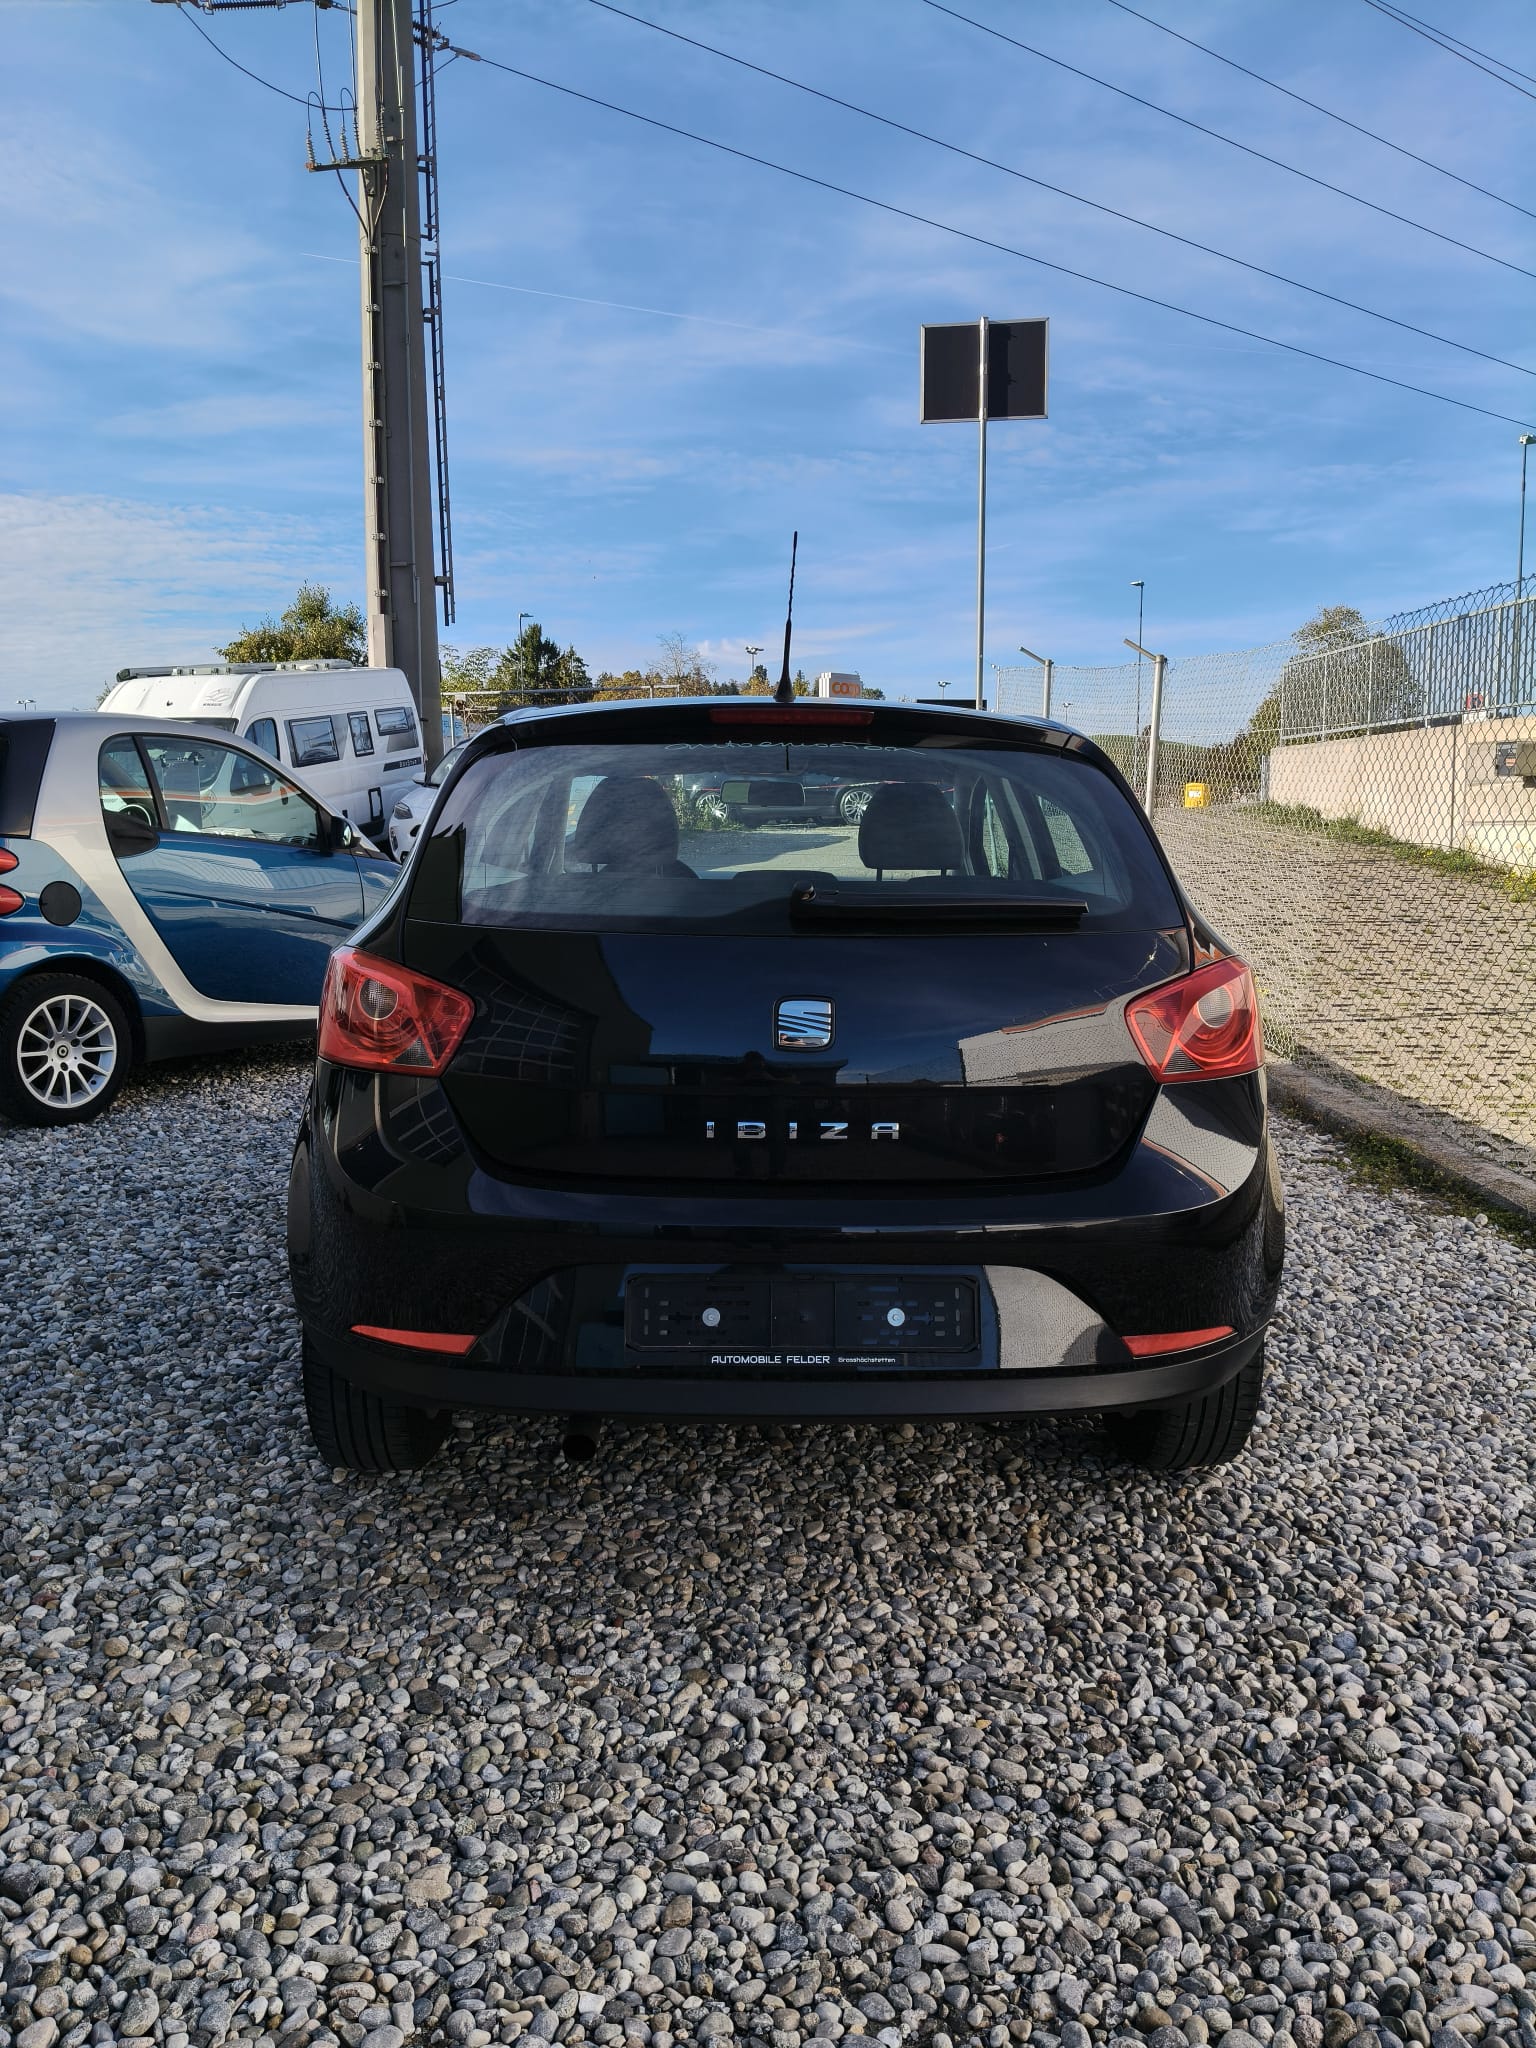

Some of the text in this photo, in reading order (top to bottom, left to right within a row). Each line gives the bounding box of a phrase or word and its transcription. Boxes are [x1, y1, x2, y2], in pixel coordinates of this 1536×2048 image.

[706, 1121, 900, 1140] IBIZA
[711, 1355, 782, 1364] AUTOMOBILE
[786, 1355, 831, 1364] FELDER
